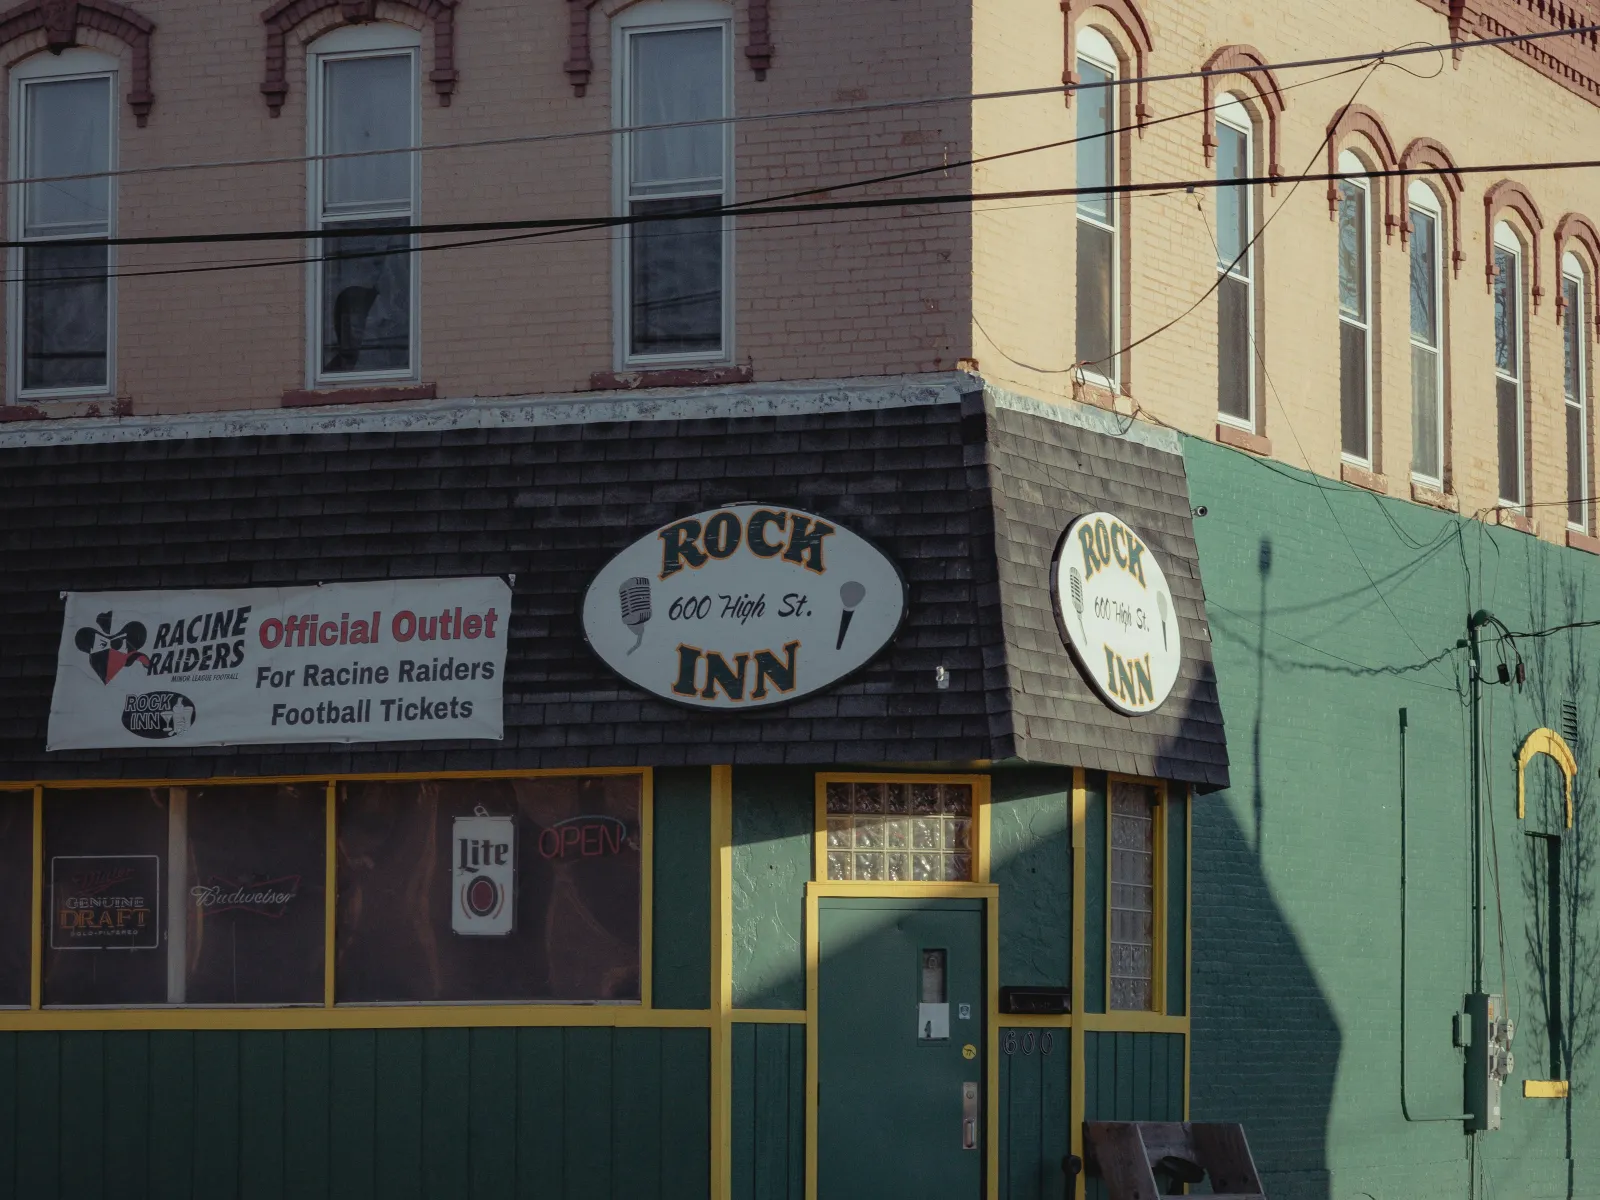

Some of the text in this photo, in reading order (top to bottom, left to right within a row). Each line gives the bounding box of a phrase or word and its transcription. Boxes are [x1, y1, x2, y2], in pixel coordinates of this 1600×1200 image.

[658, 510, 836, 581] ROCK
[1077, 517, 1147, 589] ROCK
[668, 593, 812, 625] 600 High St.
[1094, 596, 1150, 633] 600 High St.
[153, 605, 252, 649] RACINE
[258, 607, 498, 650] Official Outlet
[147, 639, 245, 676] RAIDERS
[256, 656, 495, 688] For Racine Raiders
[671, 640, 802, 702] INN
[171, 672, 239, 683] MINOR LEAGUE FOOTBALL
[1103, 643, 1155, 706] INN
[124, 693, 174, 712] ROCK
[271, 696, 474, 726] Football Tickets
[130, 712, 161, 730] INN
[457, 838, 509, 873] Lite
[538, 825, 620, 858] OPEN
[65, 896, 145, 909] GENUINE
[190, 885, 293, 907] Budweiser
[59, 908, 151, 930] DRAFT
[1003, 1031, 1054, 1055] 600
